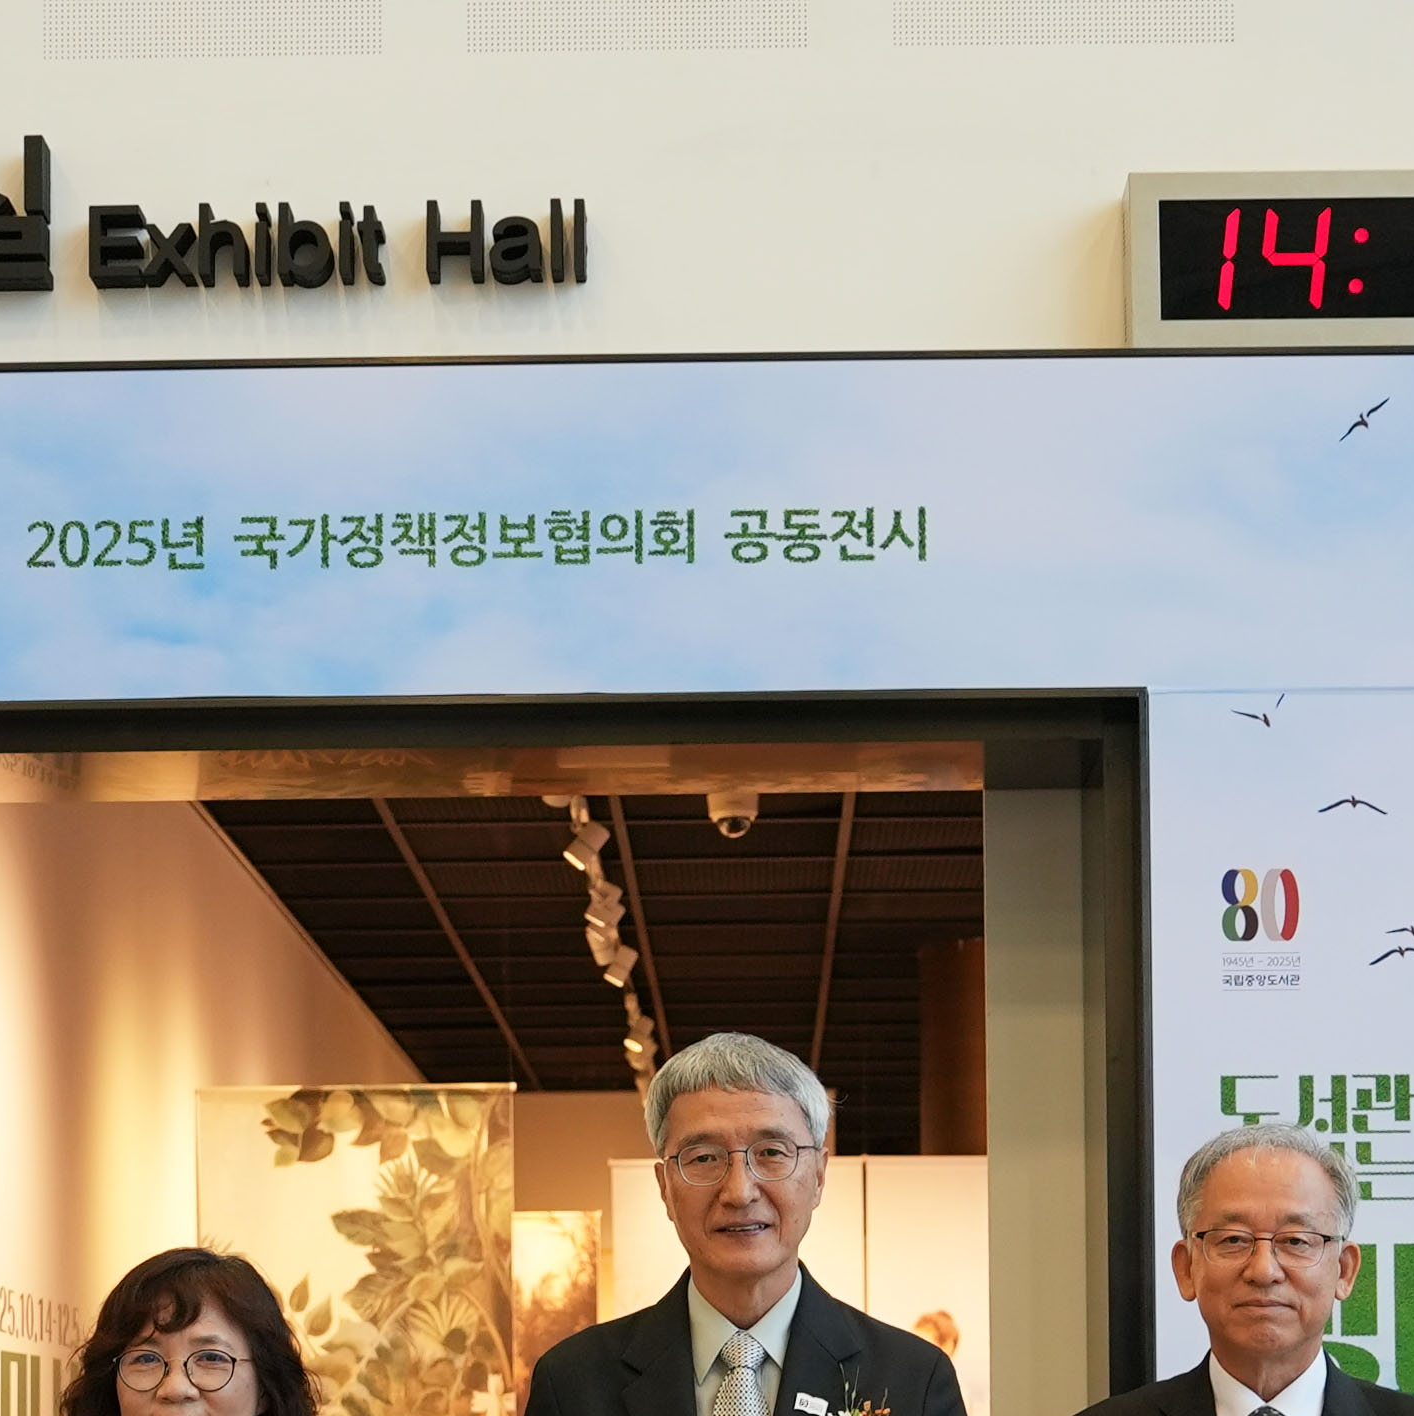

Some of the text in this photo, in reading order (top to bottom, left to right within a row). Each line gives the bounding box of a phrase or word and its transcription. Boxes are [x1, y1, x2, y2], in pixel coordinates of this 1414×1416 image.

[87, 197, 588, 289] Exhibit Hall
[25, 506, 929, 572] 2025년 국가정책정보협의회 공동전시
[1221, 868, 1300, 941] 80
[1222, 956, 1254, 968] 1945년
[1267, 955, 1301, 968] 2025년
[1222, 974, 1301, 987] 국립중앙도서관
